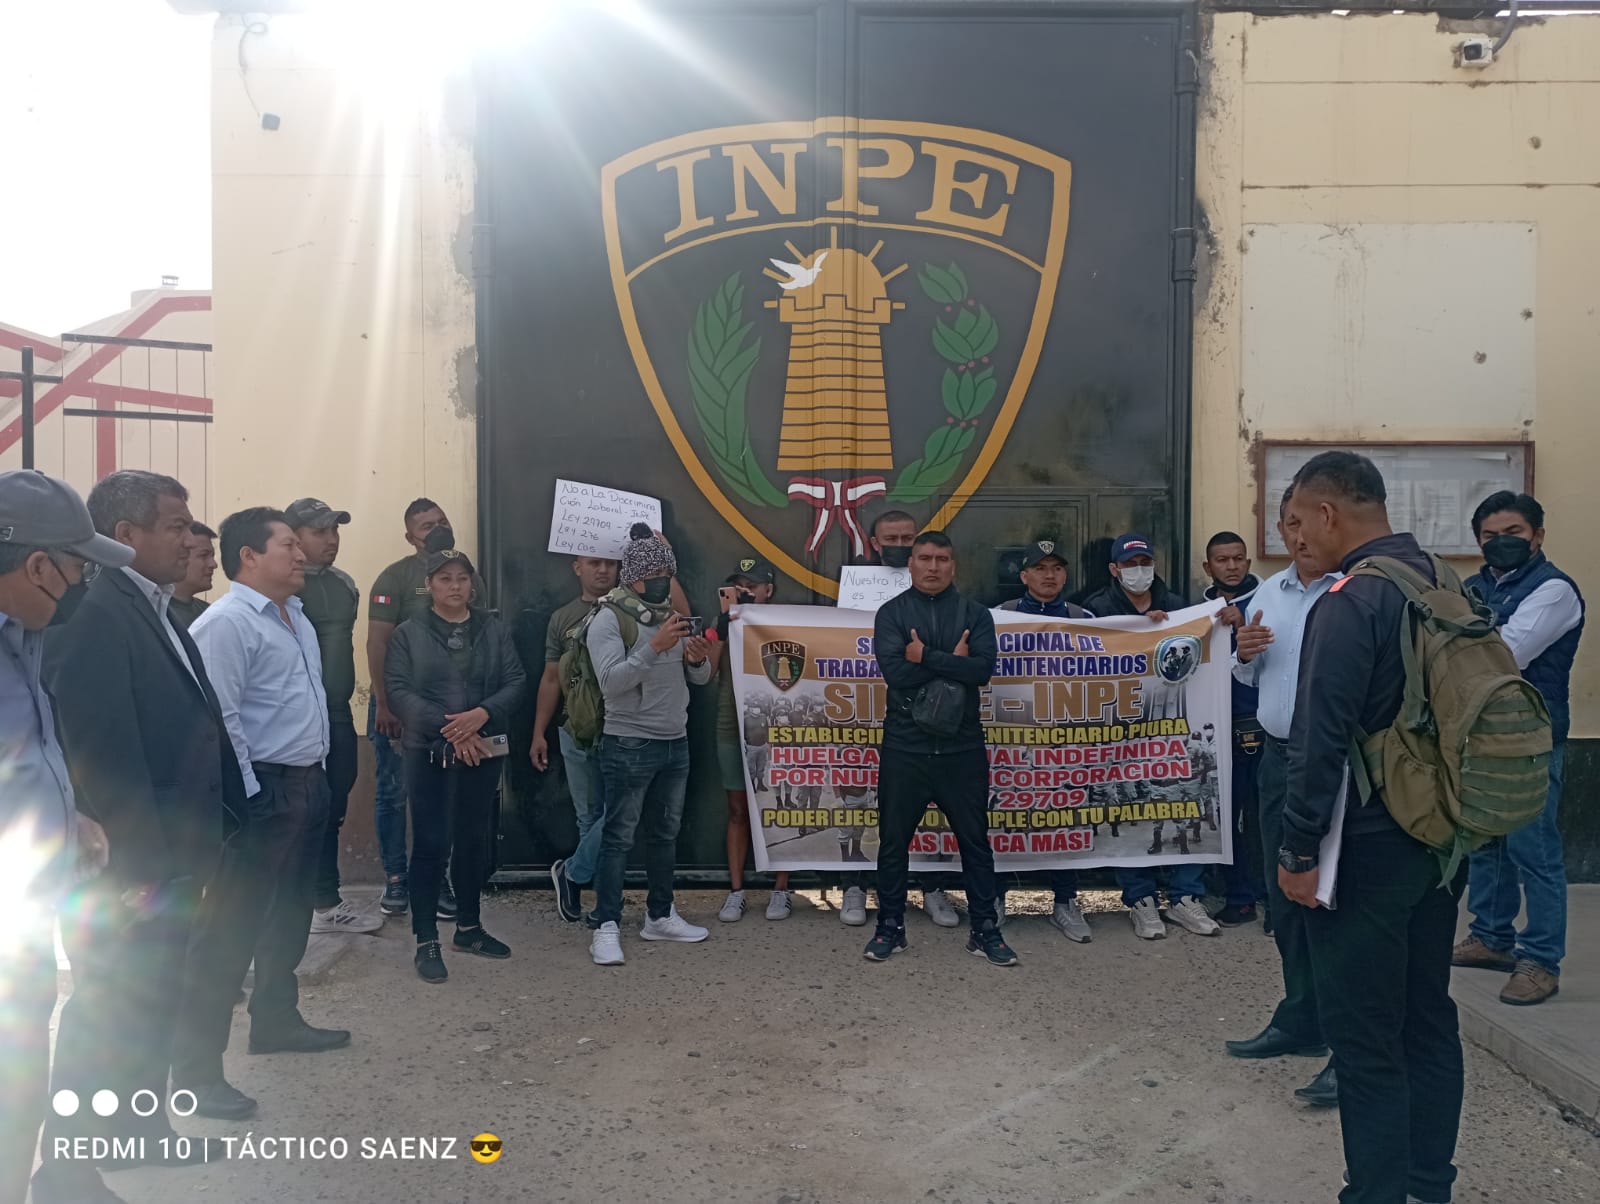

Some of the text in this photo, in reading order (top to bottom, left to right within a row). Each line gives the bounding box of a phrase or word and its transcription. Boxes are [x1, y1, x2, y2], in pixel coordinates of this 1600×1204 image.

[656, 138, 1021, 243] INPE
[766, 642, 801, 655] INPE
[997, 632, 1105, 653] CIONAL DE
[992, 653, 1148, 678] ENITENCIARIOS
[1032, 679, 1144, 723] INPE
[983, 725, 1127, 745] NITENCIARIO
[1127, 717, 1191, 739] PIURA
[773, 748, 880, 765] HUELGA
[1034, 740, 1186, 766] INDEFINIDA
[770, 769, 824, 786] POR
[988, 760, 1191, 787] CORPORACIÓN
[998, 789, 1086, 809] 29709
[763, 809, 829, 827] PODER
[1032, 808, 1073, 829] CON
[1077, 806, 1105, 825] TU
[1108, 801, 1201, 823] PALABRA
[1031, 829, 1091, 853] MÁS!
